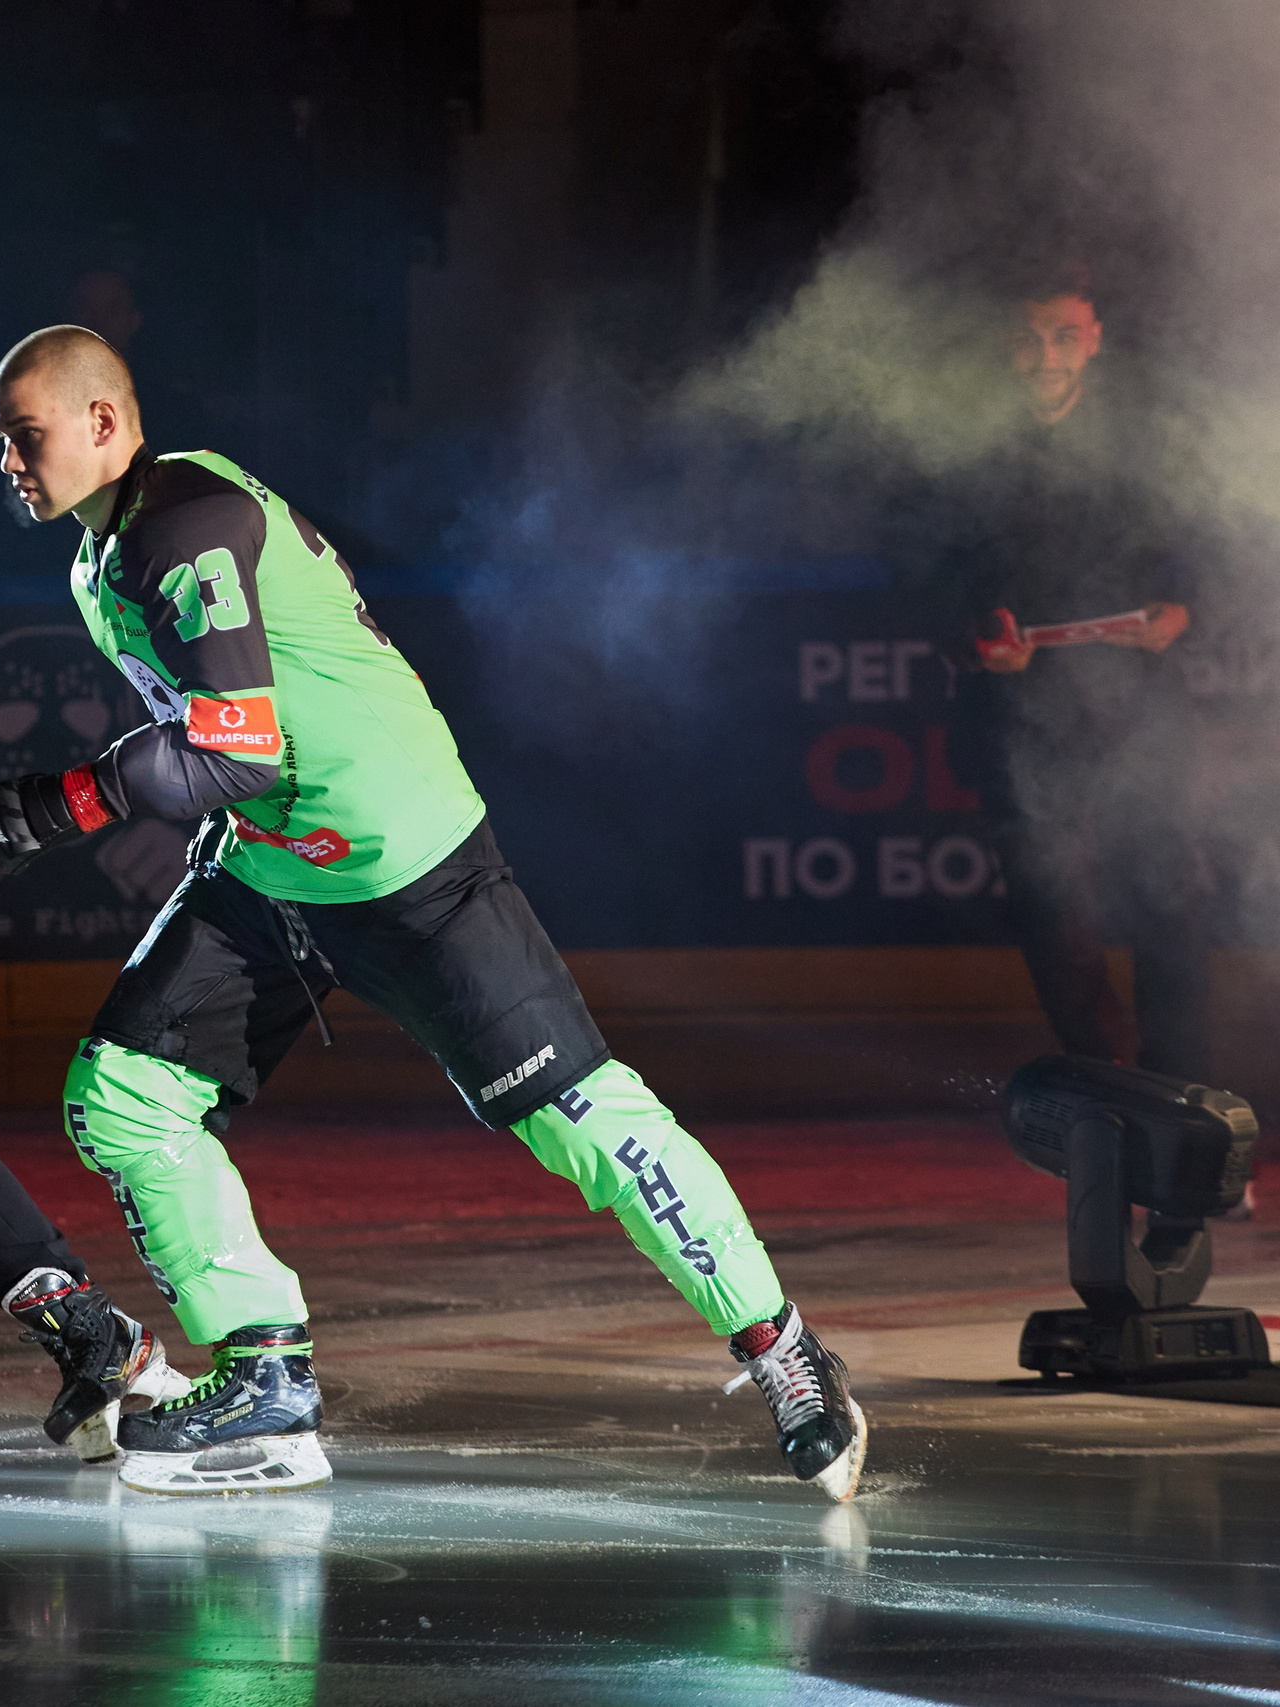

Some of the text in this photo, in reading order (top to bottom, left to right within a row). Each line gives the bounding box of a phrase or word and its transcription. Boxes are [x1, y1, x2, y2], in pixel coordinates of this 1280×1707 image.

[158, 546, 250, 643] 33
[186, 730, 275, 745] OLIMPBET
[805, 723, 980, 813] OL
[743, 836, 856, 899] ПО
[479, 1043, 557, 1103] BAUER
